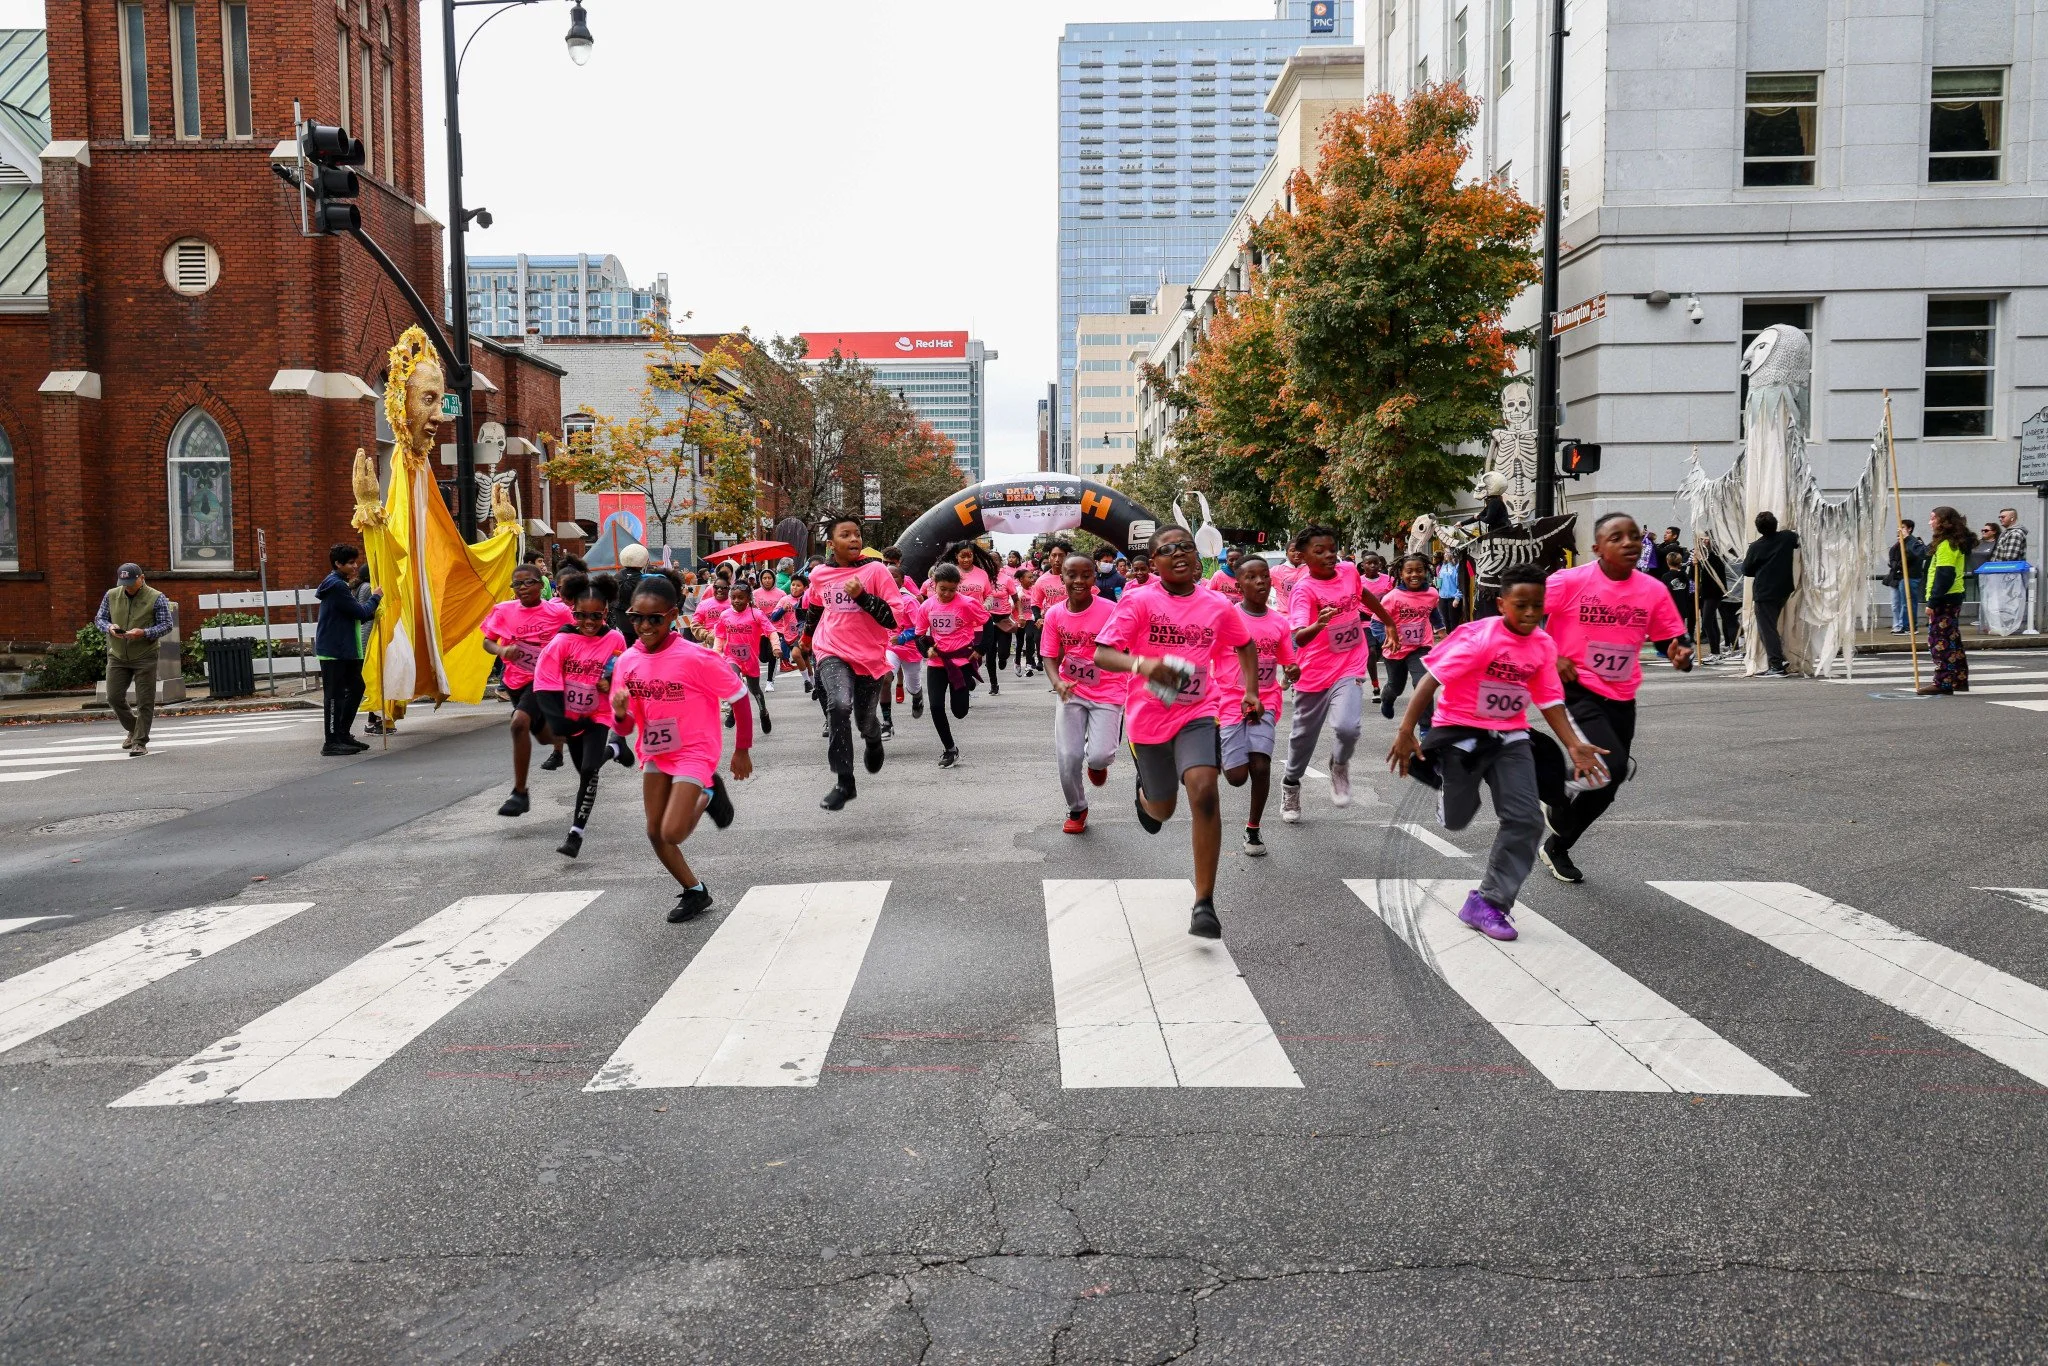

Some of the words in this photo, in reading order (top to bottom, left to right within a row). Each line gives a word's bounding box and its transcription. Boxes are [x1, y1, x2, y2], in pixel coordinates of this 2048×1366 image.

[1313, 18, 1333, 27] PNC
[1557, 304, 1591, 329] Wilmington
[915, 339, 935, 348] Red
[935, 339, 954, 348] Hat
[451, 396, 458, 405] ST
[450, 405, 459, 414] 100
[1006, 487, 1026, 495] DAY
[1006, 494, 1034, 502] DEAD
[953, 496, 978, 526] F
[1081, 489, 1113, 520] H
[835, 592, 857, 605] 84
[1580, 604, 1609, 616] DAY
[932, 618, 951, 629] 852
[1580, 614, 1617, 624] DEAD
[516, 624, 545, 635] citrix
[1150, 625, 1178, 636] DAY
[1404, 629, 1424, 639] 912
[1149, 634, 1186, 645] DEAD
[1334, 627, 1359, 645] 920
[731, 647, 747, 657] 811
[1593, 653, 1629, 672] 917
[1069, 664, 1095, 680] 914
[1257, 667, 1274, 681] 27
[567, 690, 594, 707] 815
[1486, 693, 1523, 712] 906
